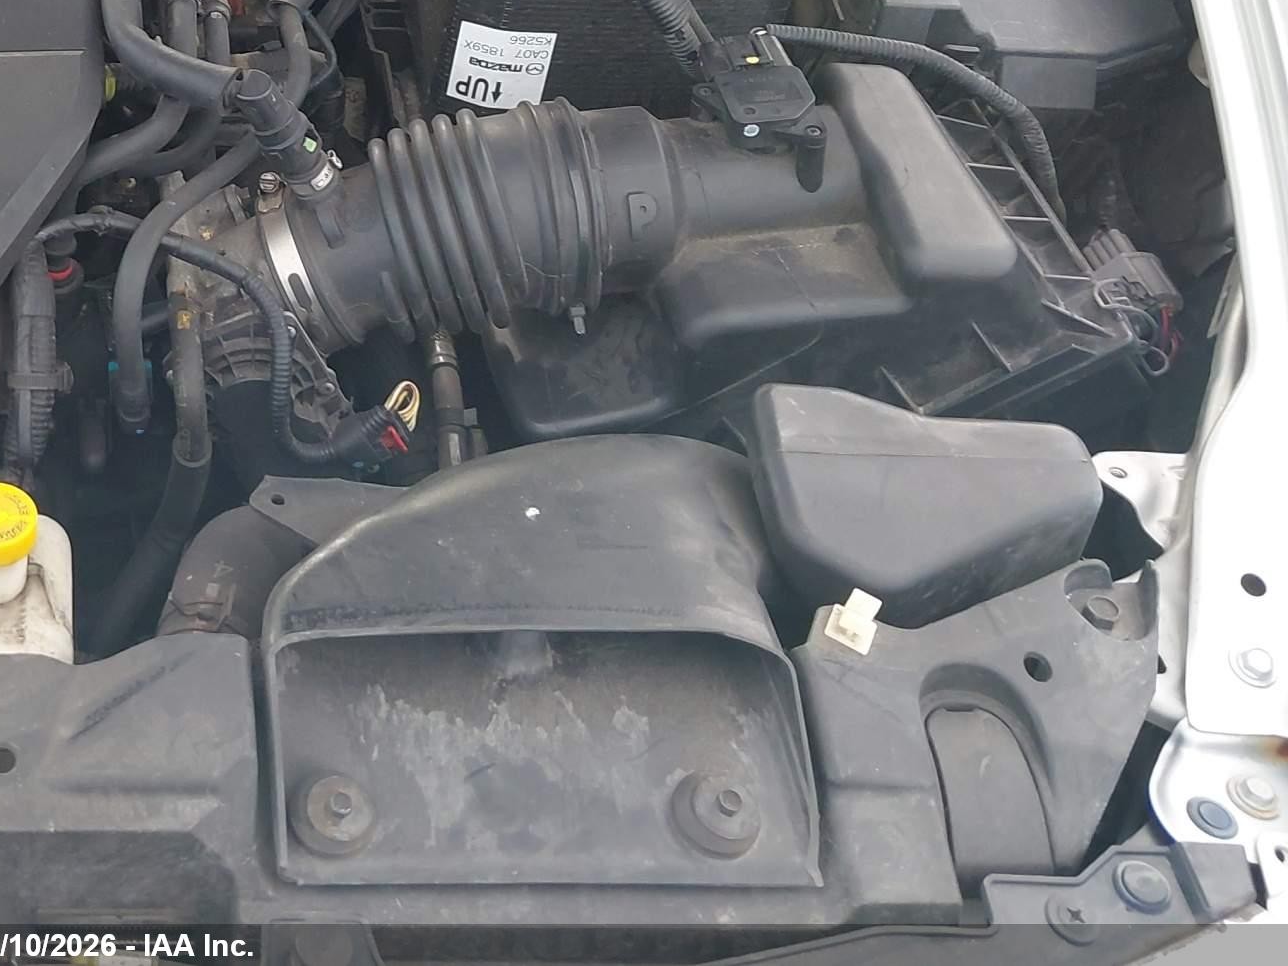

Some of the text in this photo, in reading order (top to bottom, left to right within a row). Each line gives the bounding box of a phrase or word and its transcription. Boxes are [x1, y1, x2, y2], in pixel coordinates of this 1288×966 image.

[464, 40, 549, 59] CA07 1859X
[510, 35, 553, 46] K5266
[455, 75, 489, 102] UP
